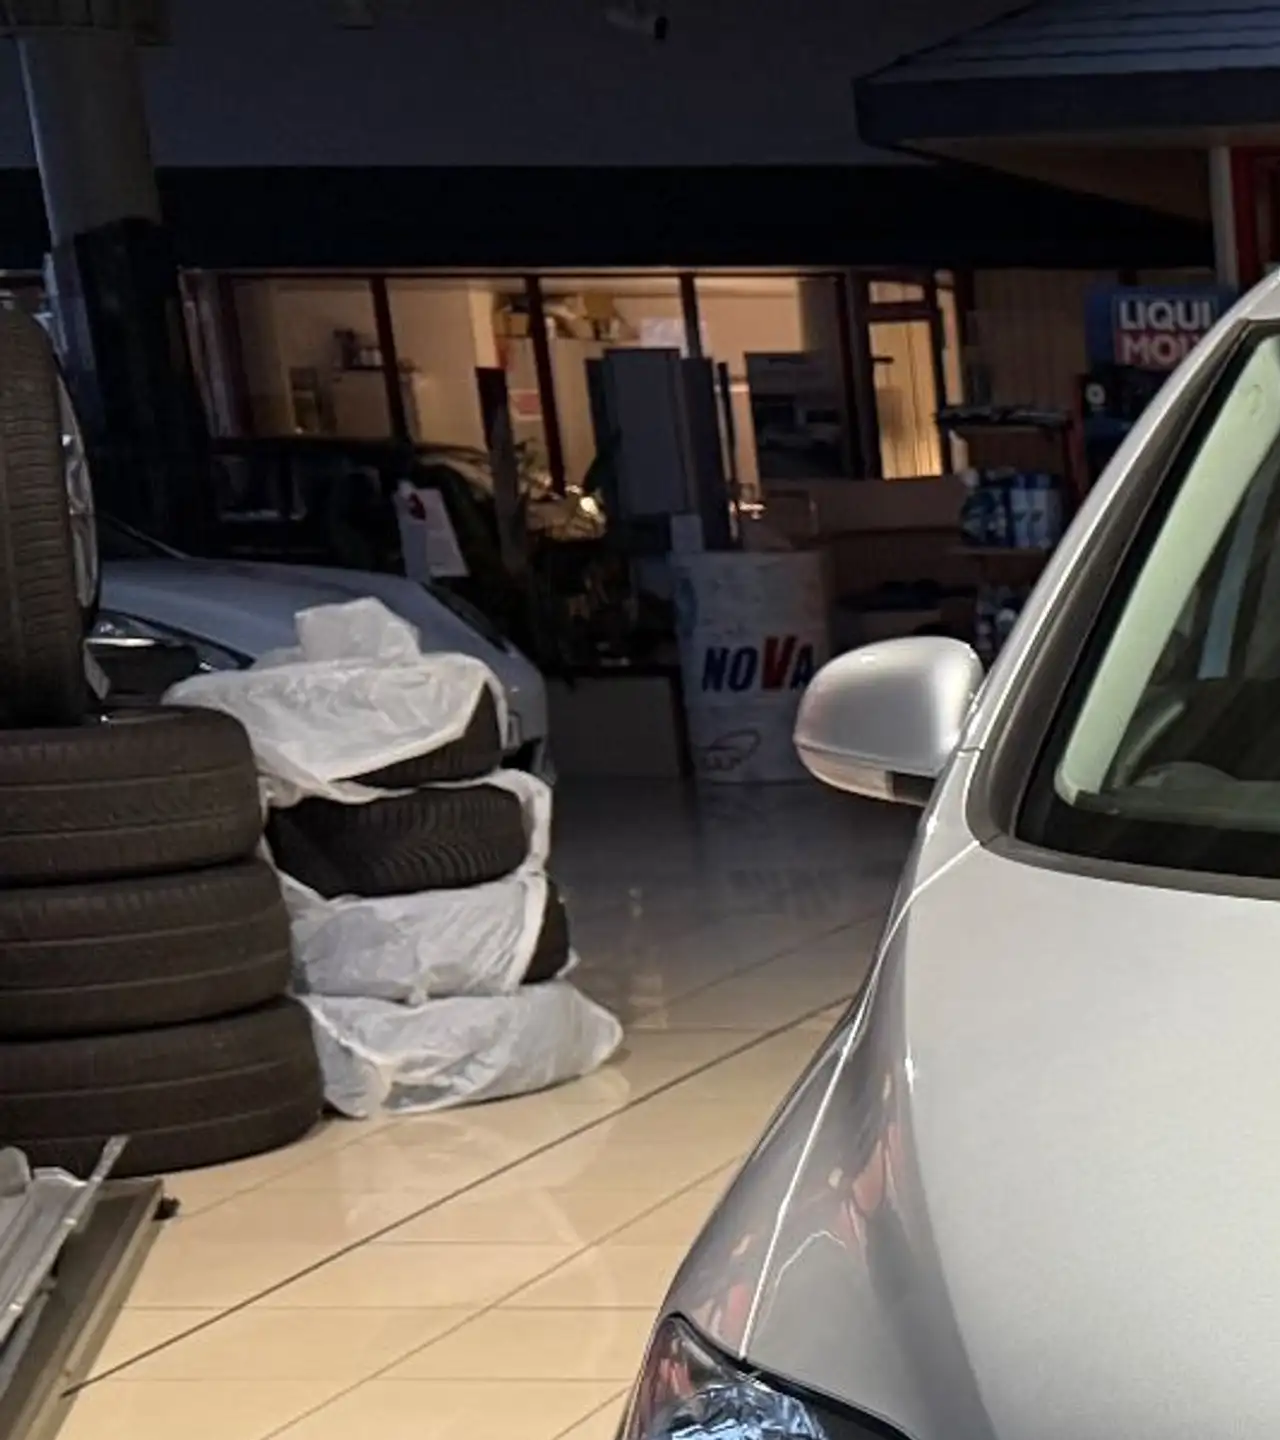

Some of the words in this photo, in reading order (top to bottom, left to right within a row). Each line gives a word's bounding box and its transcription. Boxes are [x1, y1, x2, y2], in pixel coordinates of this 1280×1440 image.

[1119, 299, 1213, 332] LIQUI
[1121, 332, 1201, 366] MOL
[702, 636, 816, 693] NOVA
